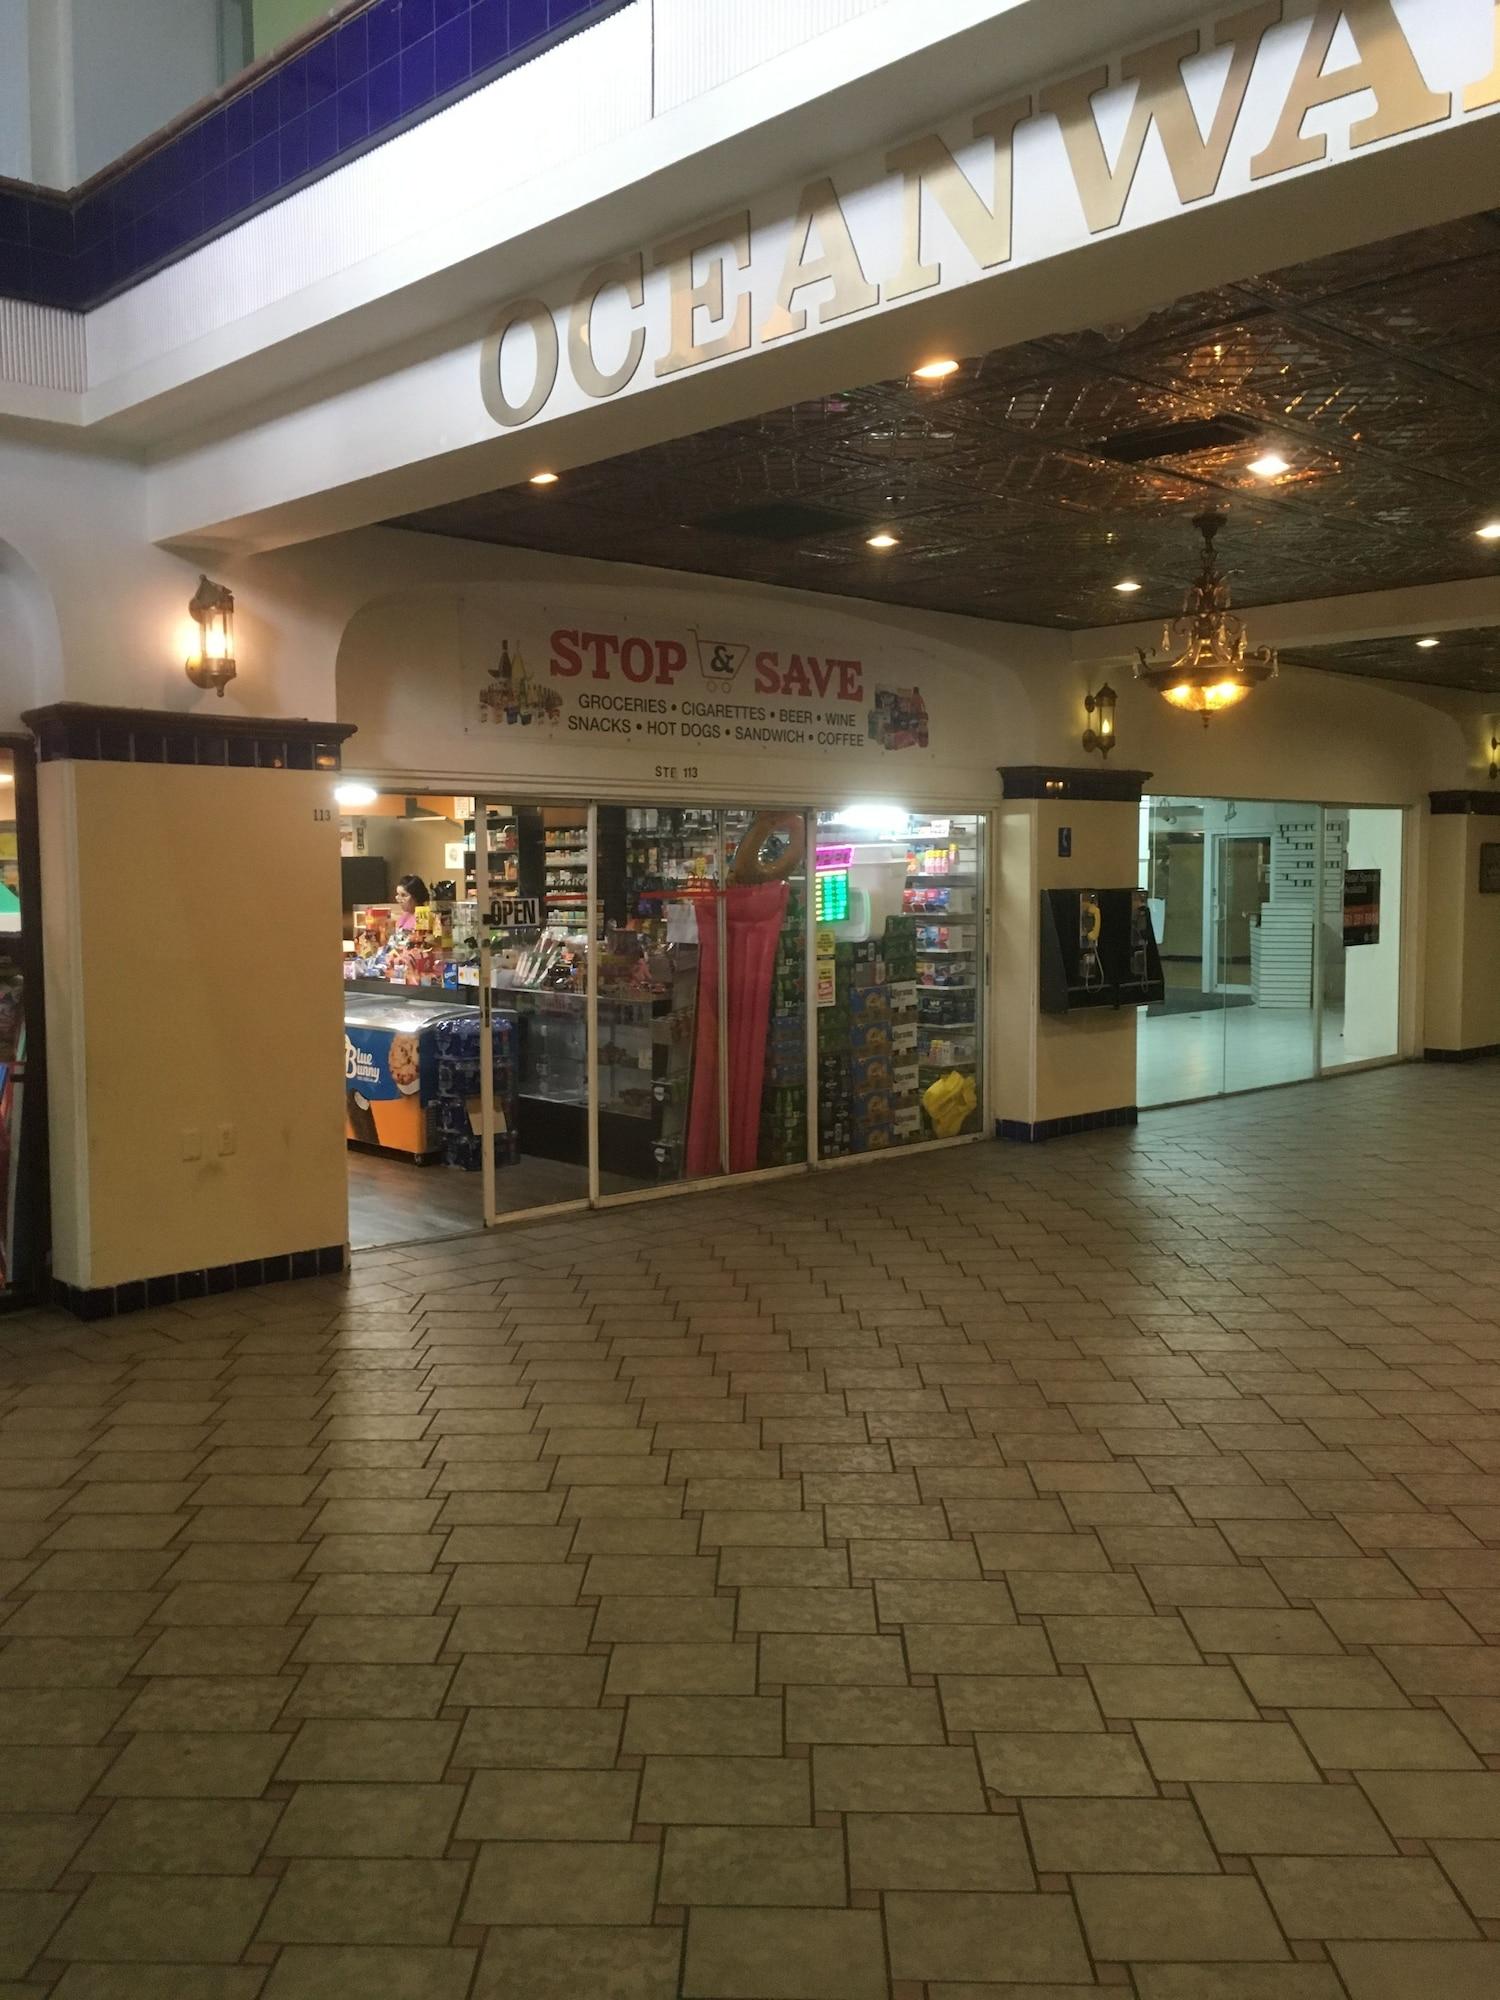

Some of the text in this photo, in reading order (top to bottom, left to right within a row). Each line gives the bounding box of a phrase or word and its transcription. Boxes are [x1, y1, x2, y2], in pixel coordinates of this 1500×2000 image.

[479, 0, 1500, 428] OCEANWA
[550, 629, 864, 702] STOP & SAVE
[578, 693, 856, 727] GROCERIES CIGARETTES BEER WINE
[568, 715, 865, 747] SNACKS HOT DOGS SANDWICH COFFEE
[655, 765, 698, 778] STE 113
[313, 808, 331, 821] 113
[491, 899, 536, 926] OPEN
[345, 1045, 373, 1077] Blue
